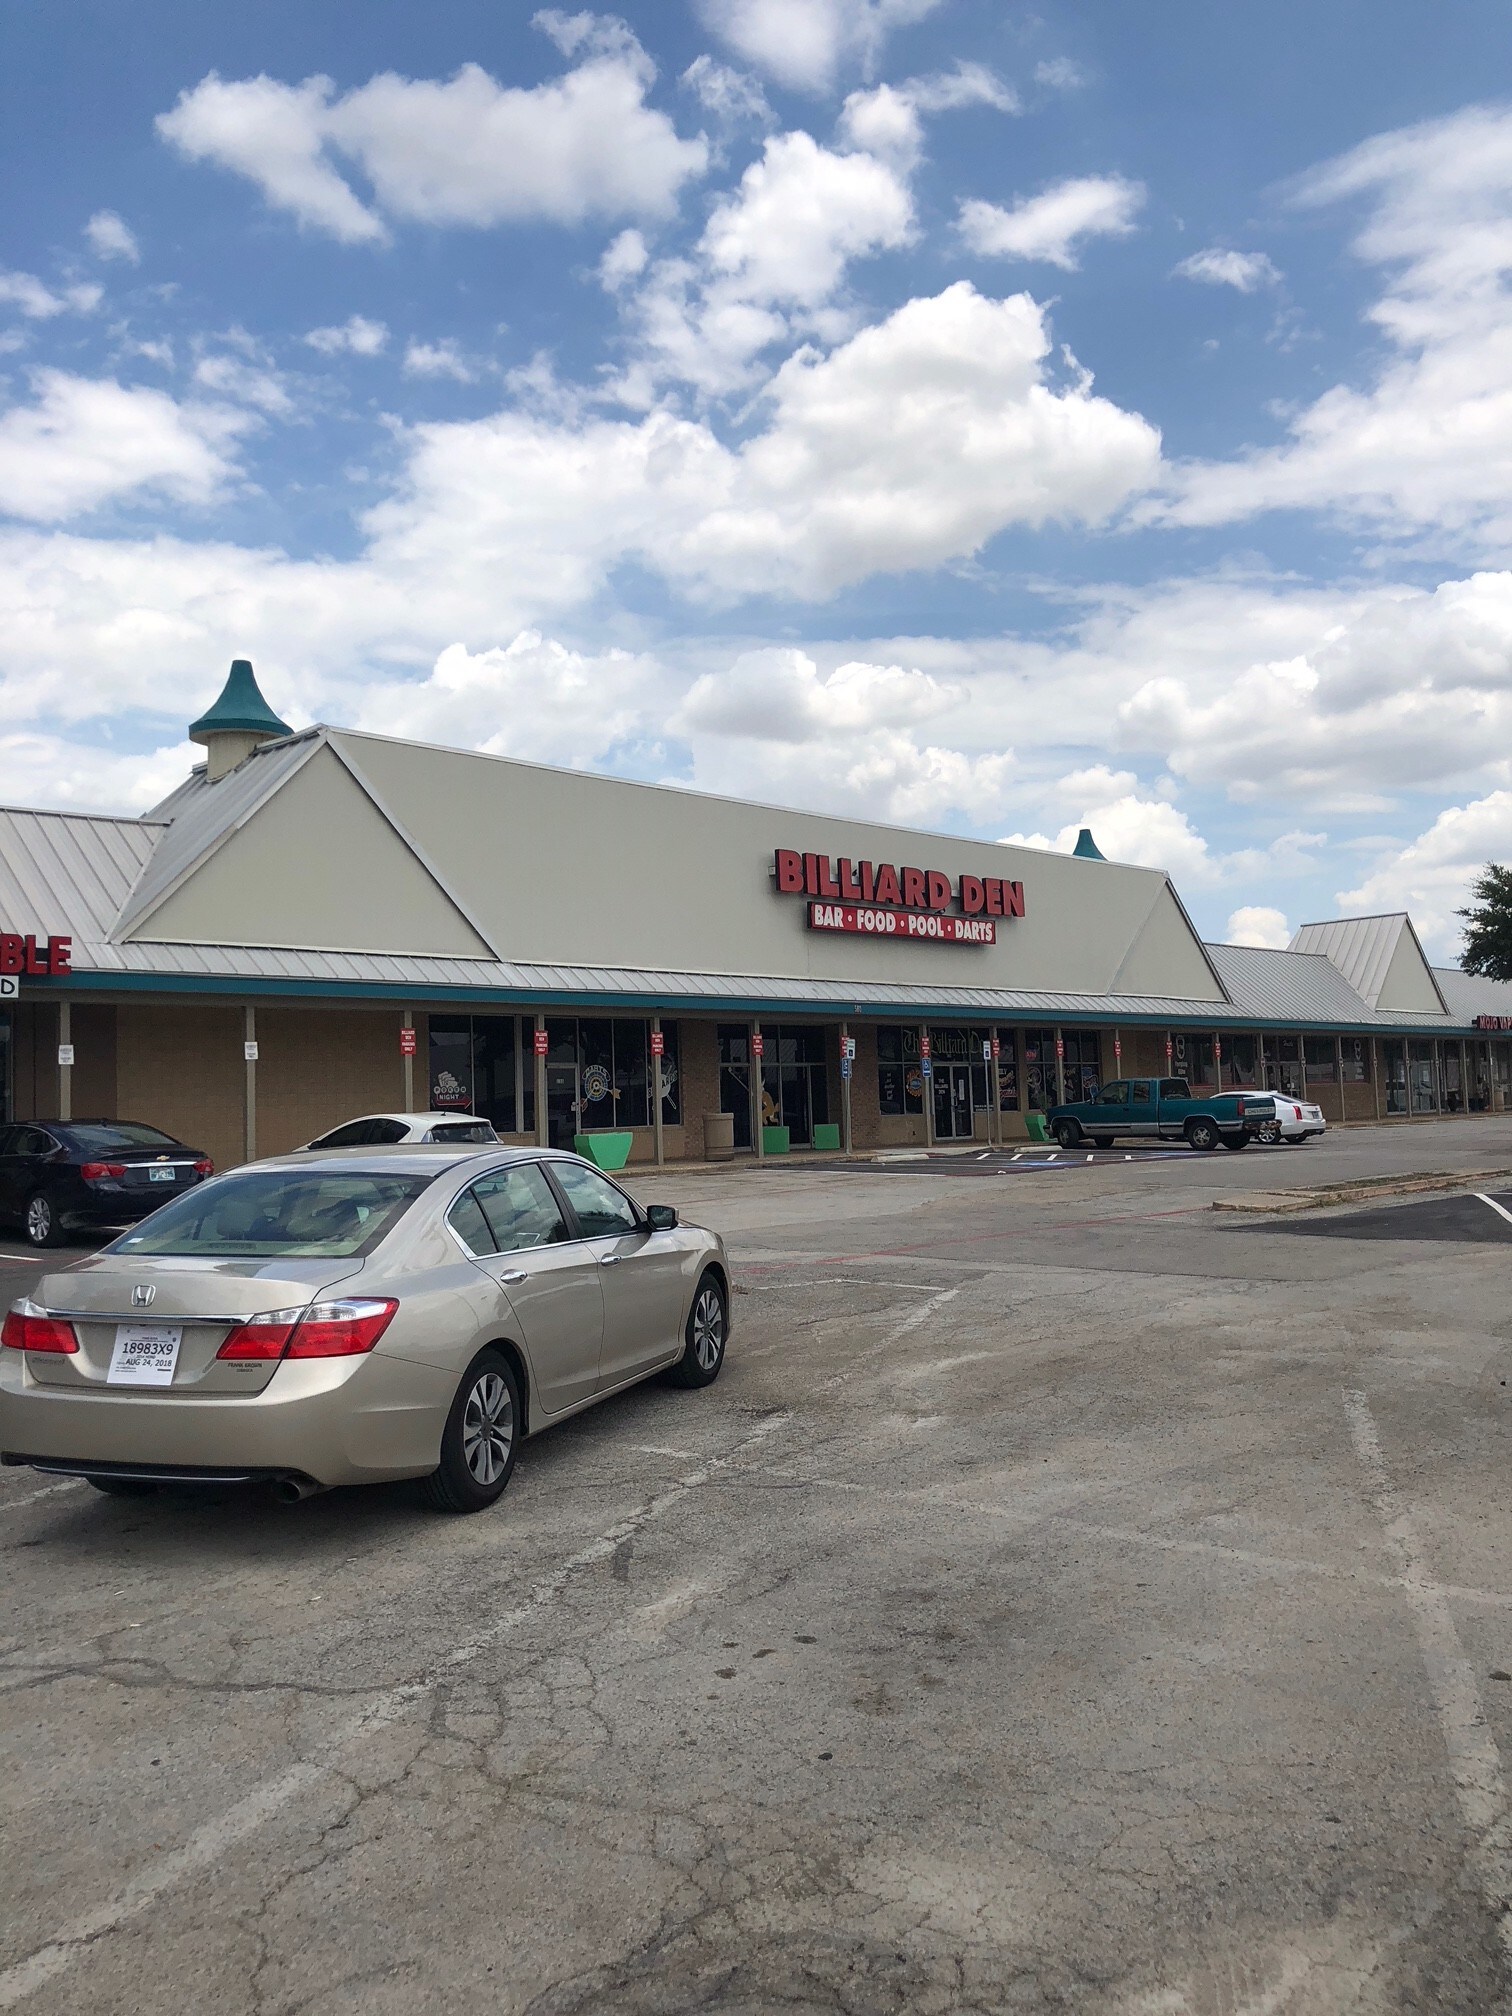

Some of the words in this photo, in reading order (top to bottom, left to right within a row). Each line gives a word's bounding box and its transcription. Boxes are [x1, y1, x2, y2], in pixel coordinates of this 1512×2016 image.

[775, 849, 952, 909] BILLIARD
[959, 874, 1025, 917] DEN
[814, 904, 844, 927] BAR
[857, 910, 896, 932] FOOD
[908, 915, 944, 937] POOL
[955, 919, 993, 941] DARTS
[1479, 1016, 1498, 1029] MOJO
[122, 1342, 174, 1355] 18983X9
[125, 1358, 140, 1366] AUG
[142, 1359, 153, 1367] 24,
[155, 1359, 173, 1367] 2018
